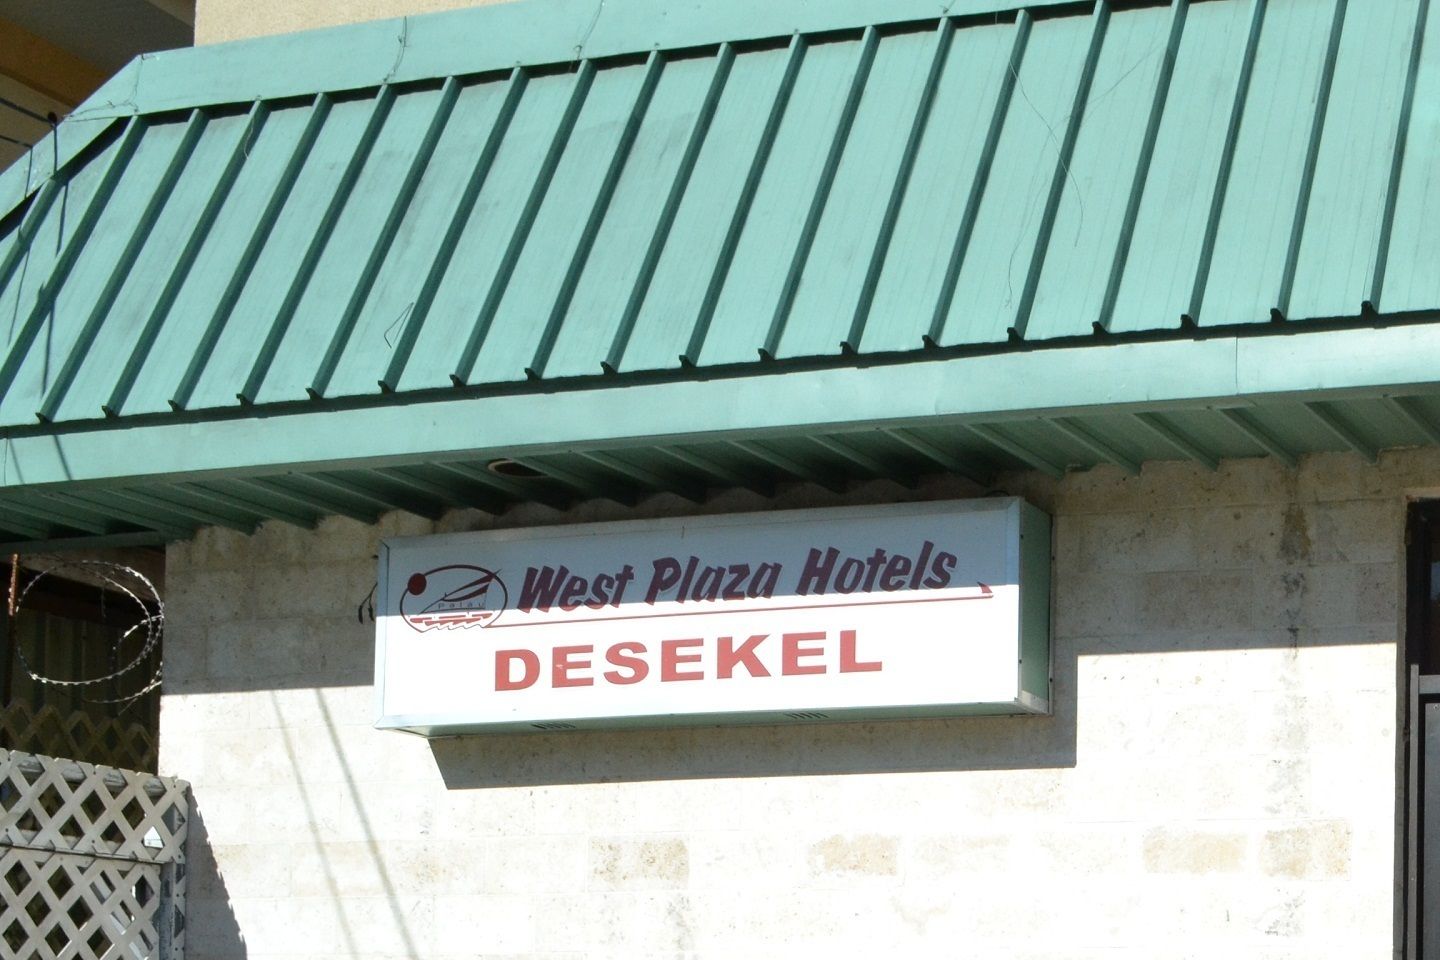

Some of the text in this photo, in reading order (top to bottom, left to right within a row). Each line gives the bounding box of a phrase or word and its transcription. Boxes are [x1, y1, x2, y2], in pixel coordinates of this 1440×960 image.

[517, 540, 958, 614] West Plaza Hotels
[495, 629, 882, 692] DESEKEL
